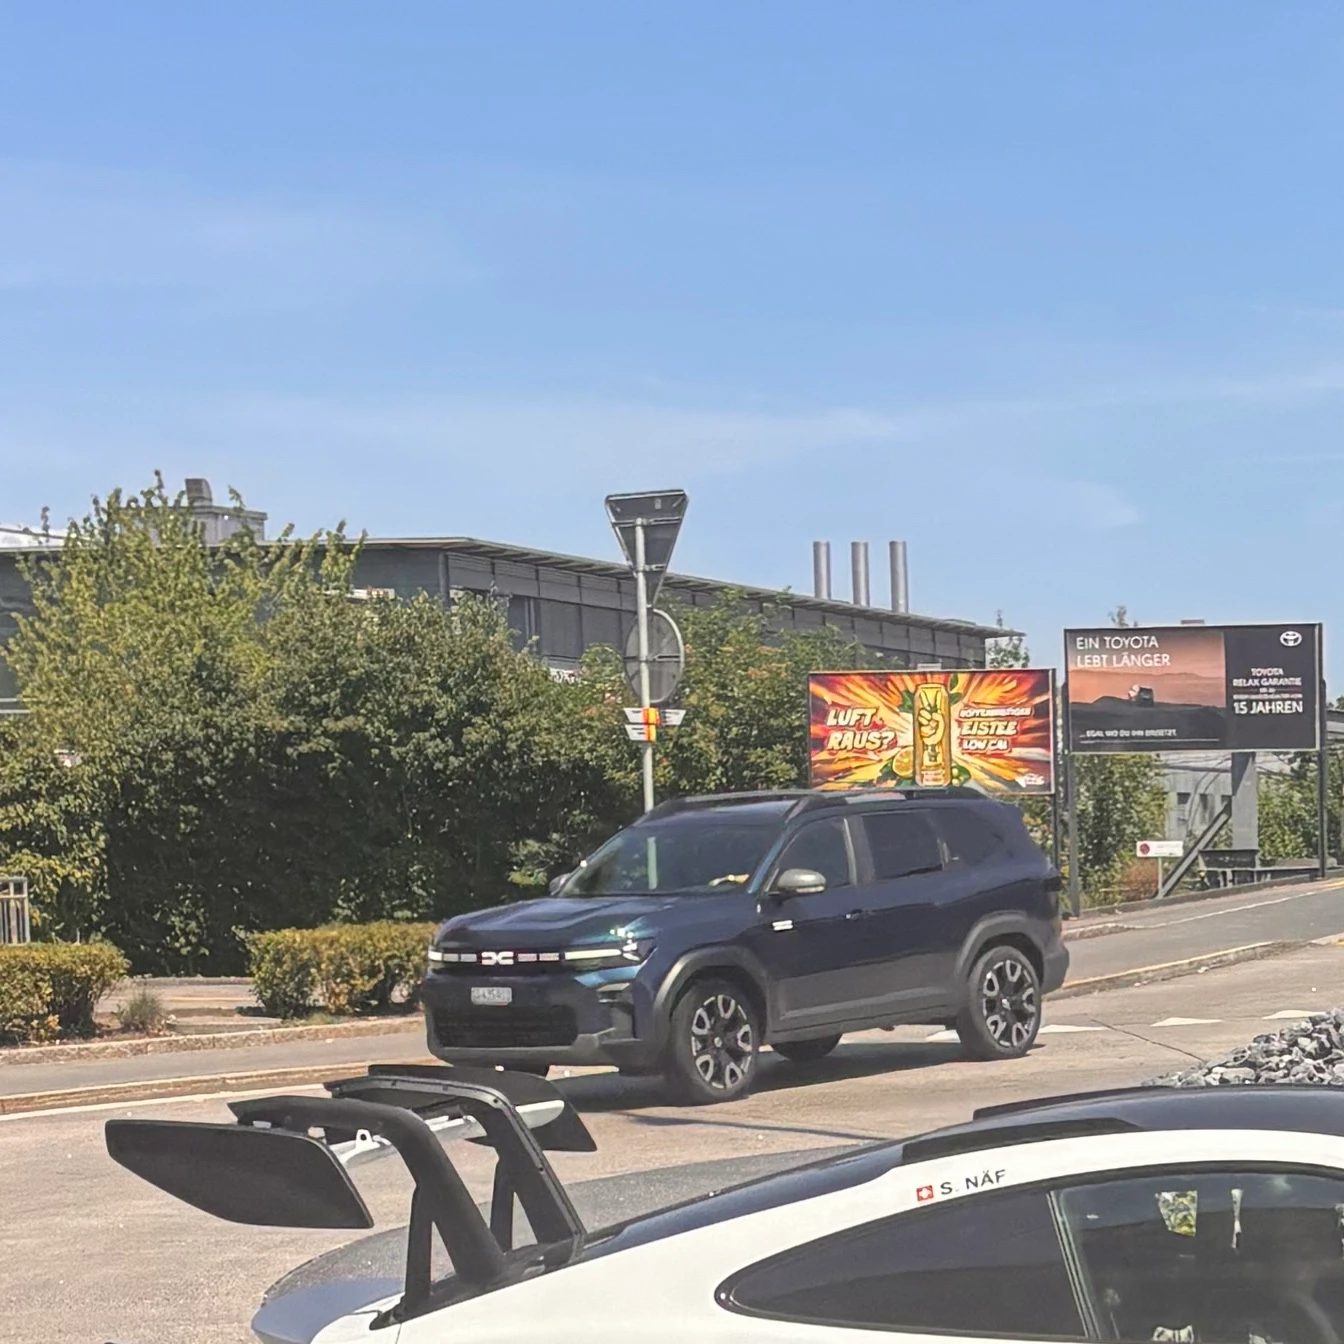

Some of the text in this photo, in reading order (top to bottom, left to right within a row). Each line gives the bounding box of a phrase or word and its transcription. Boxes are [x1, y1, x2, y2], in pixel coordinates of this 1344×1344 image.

[1076, 635, 1159, 650] EIN TOYOTA
[1077, 652, 1171, 668] LEBT LÄNGER
[1251, 667, 1284, 677] TOYOTA
[1233, 700, 1303, 714] 15 JAHREN
[827, 707, 877, 727] LUFT
[961, 721, 1017, 736] EISTEE
[827, 731, 895, 750] RAUS?
[963, 739, 987, 750] LOW
[965, 1169, 1006, 1190] NÄF
